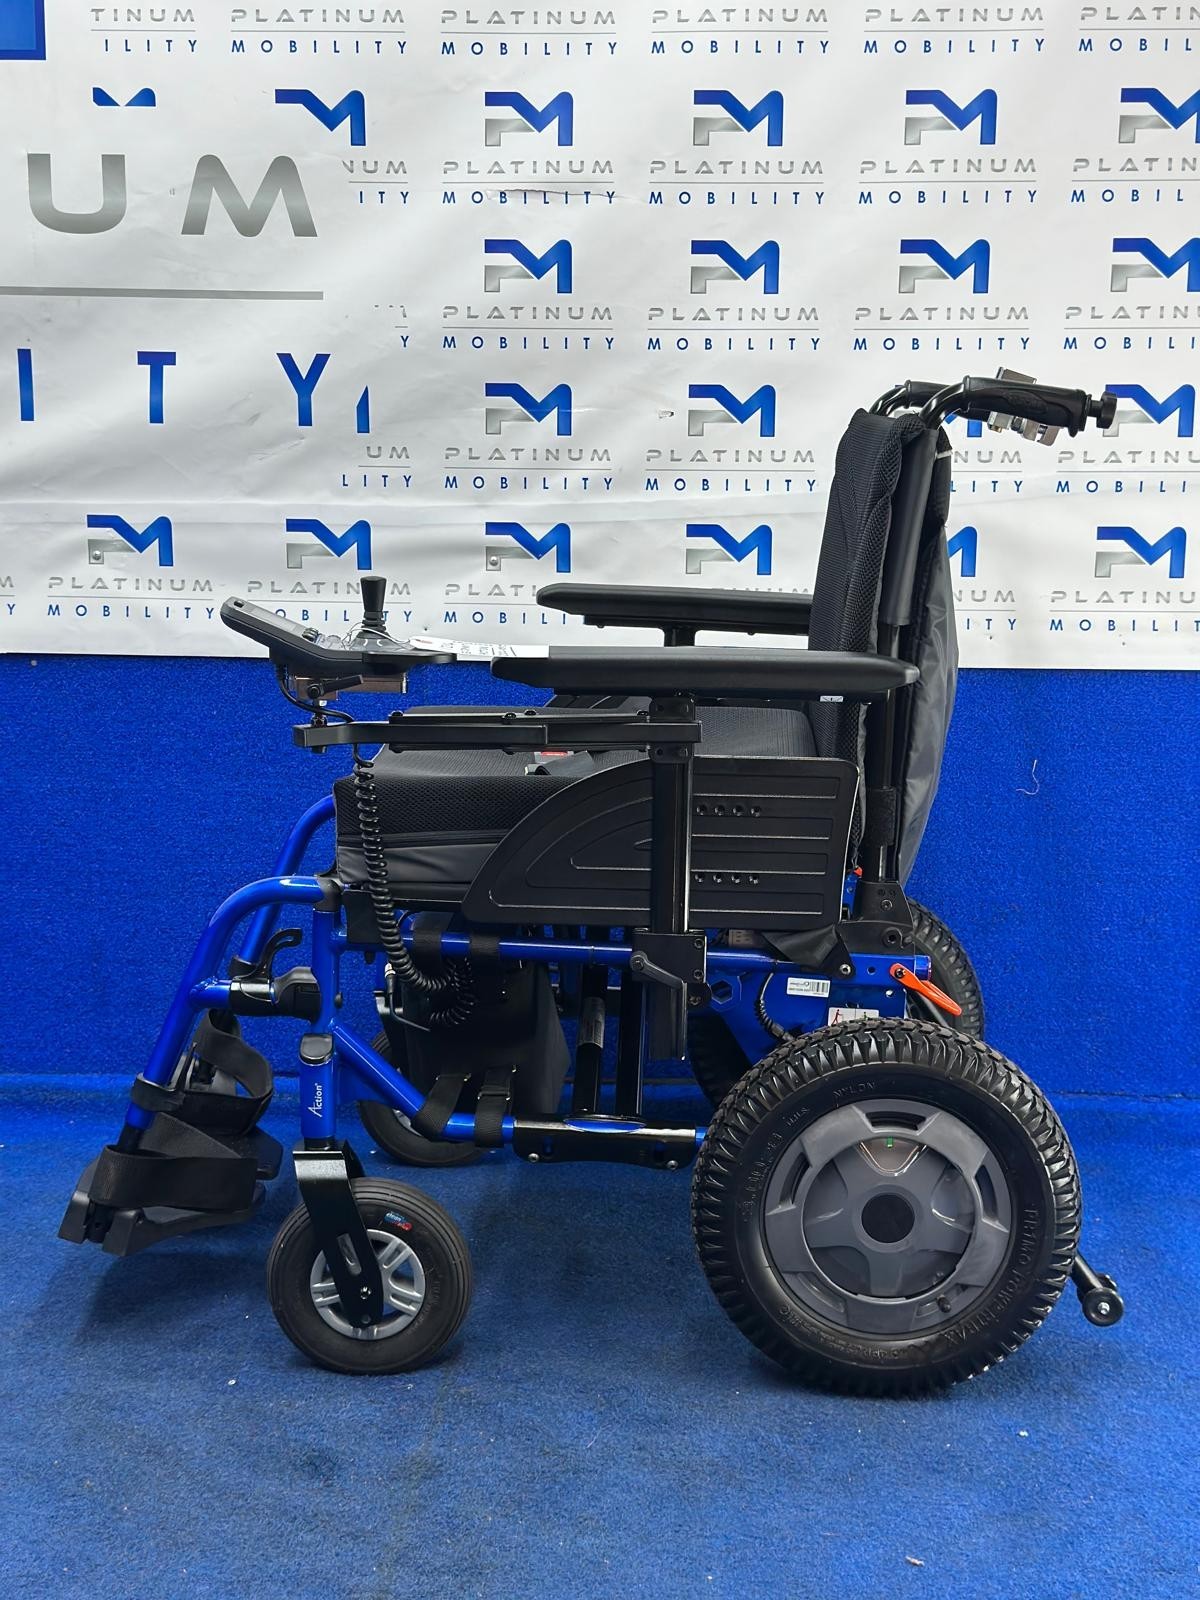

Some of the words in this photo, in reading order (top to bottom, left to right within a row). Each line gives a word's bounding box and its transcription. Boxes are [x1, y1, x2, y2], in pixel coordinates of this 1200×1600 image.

[231, 8, 405, 24] PLATINUM
[441, 9, 616, 25] PLATINUM
[652, 7, 828, 24] PLATINUM
[865, 7, 1044, 23] PLATINUM
[231, 39, 407, 55] MOBILITY
[440, 41, 618, 56] MOBILITY
[650, 39, 830, 55] MOBILITY
[863, 37, 1046, 54] MOBILITY
[443, 159, 614, 175] PLATINUM
[649, 160, 824, 175] PLATINUM
[859, 157, 1037, 175] PLATINUM
[443, 191, 615, 205] MOBILITY
[648, 190, 825, 206] MOBILITY
[858, 189, 1038, 205] MOBILITY
[442, 305, 613, 321] PLATINUM
[647, 306, 819, 322] PLATINUM
[854, 306, 1029, 321] PLATINUM
[443, 336, 614, 350] MOBILITY
[647, 337, 821, 351] MOBILITY
[852, 336, 1031, 351] MOBILITY
[444, 446, 612, 462] PLATINUM
[645, 448, 815, 464] PLATINUM
[445, 476, 612, 491] MOBILITY
[644, 477, 817, 493] MOBILITY
[47, 576, 213, 593] PLATINUM
[247, 580, 411, 596] PLATINM
[47, 603, 215, 620] MOBILITY
[275, 608, 413, 623] OBILTY
